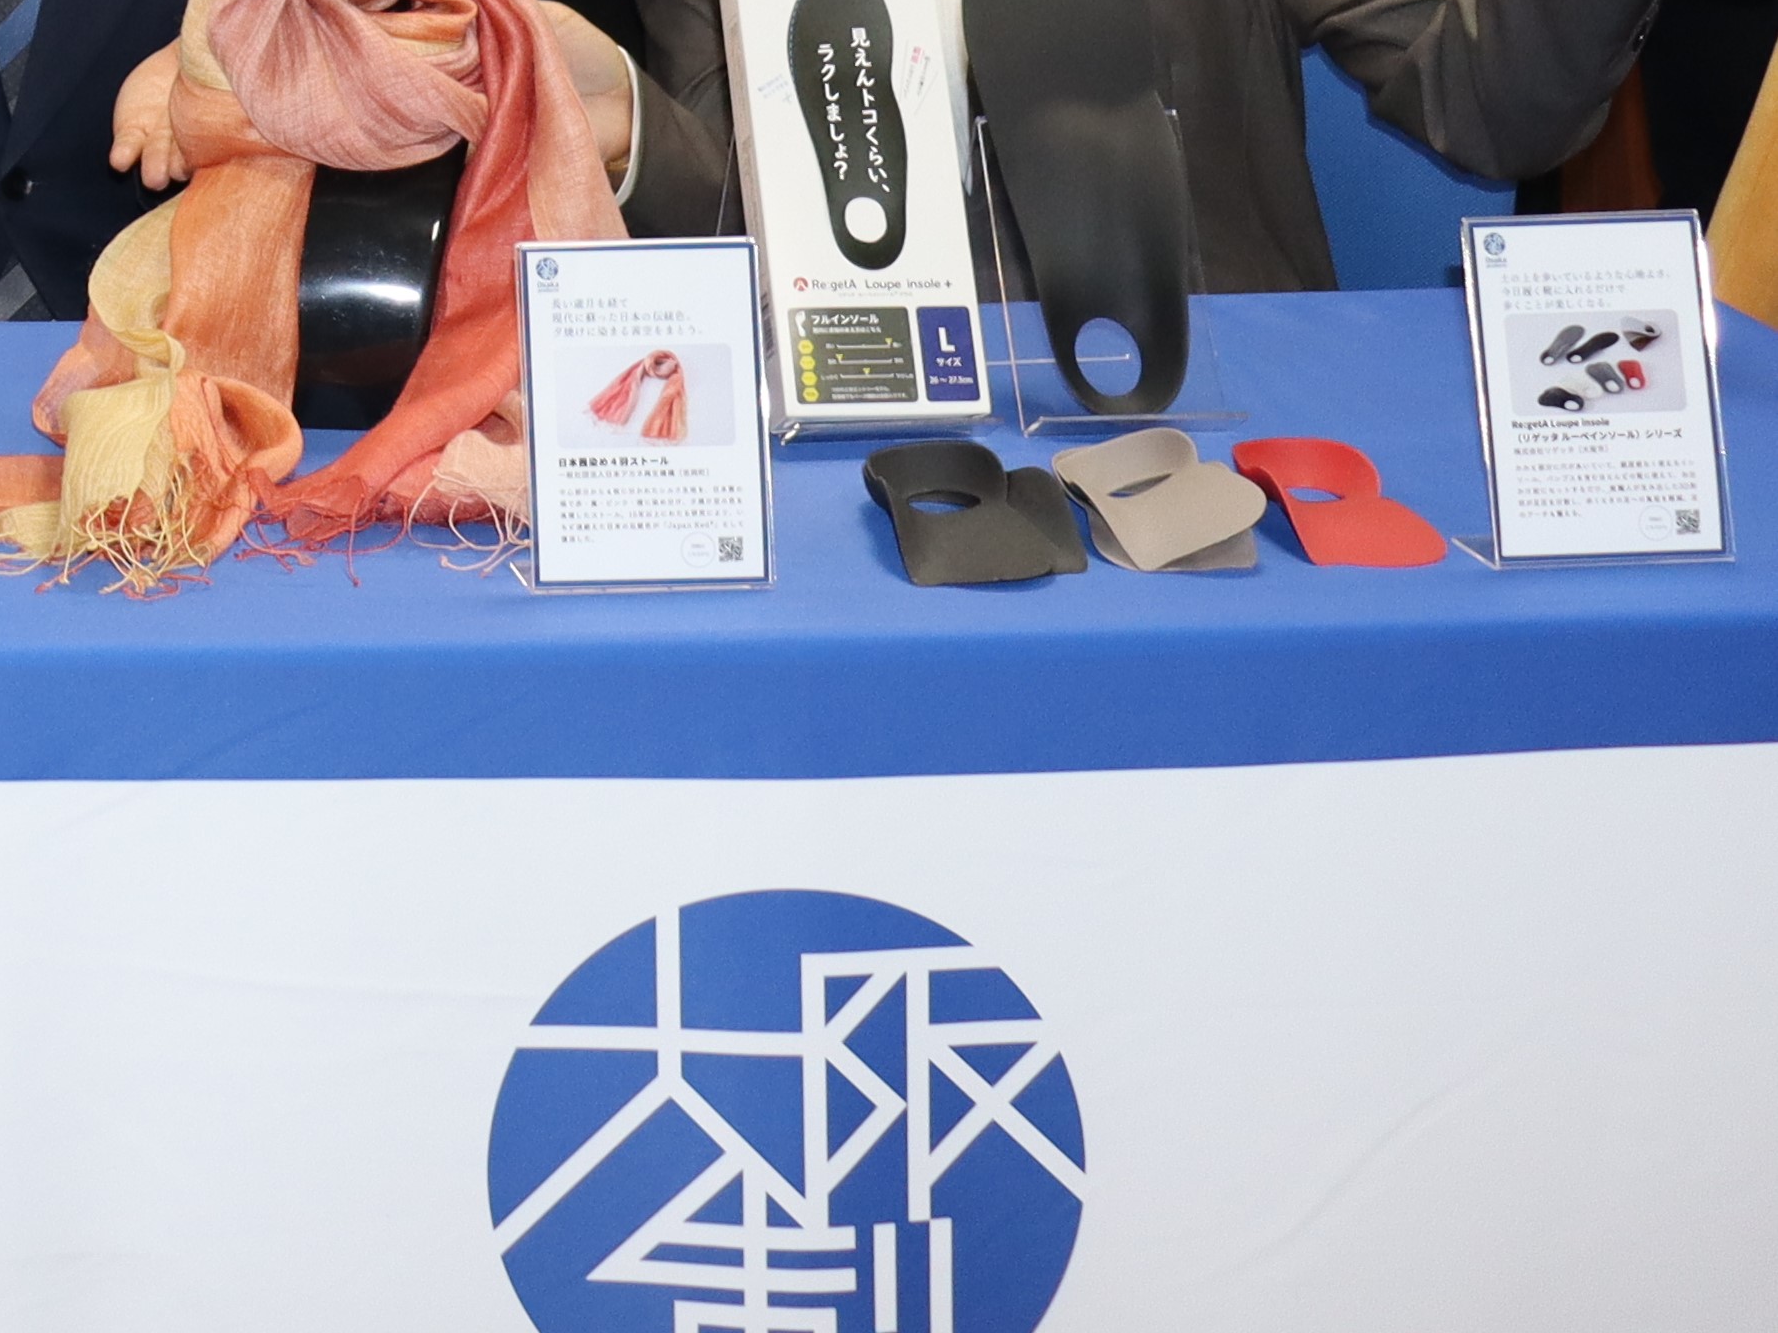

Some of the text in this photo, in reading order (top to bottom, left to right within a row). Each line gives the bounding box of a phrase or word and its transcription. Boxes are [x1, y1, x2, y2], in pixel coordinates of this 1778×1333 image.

[850, 27, 890, 193] 見えんトコくらい、
[864, 279, 901, 291] Loupe
[907, 278, 941, 289] insole
[811, 313, 880, 325] フルインソール
[938, 326, 956, 352] L
[935, 356, 963, 367] サイズ
[1550, 417, 1579, 429] Loupe
[1581, 416, 1611, 427] insole
